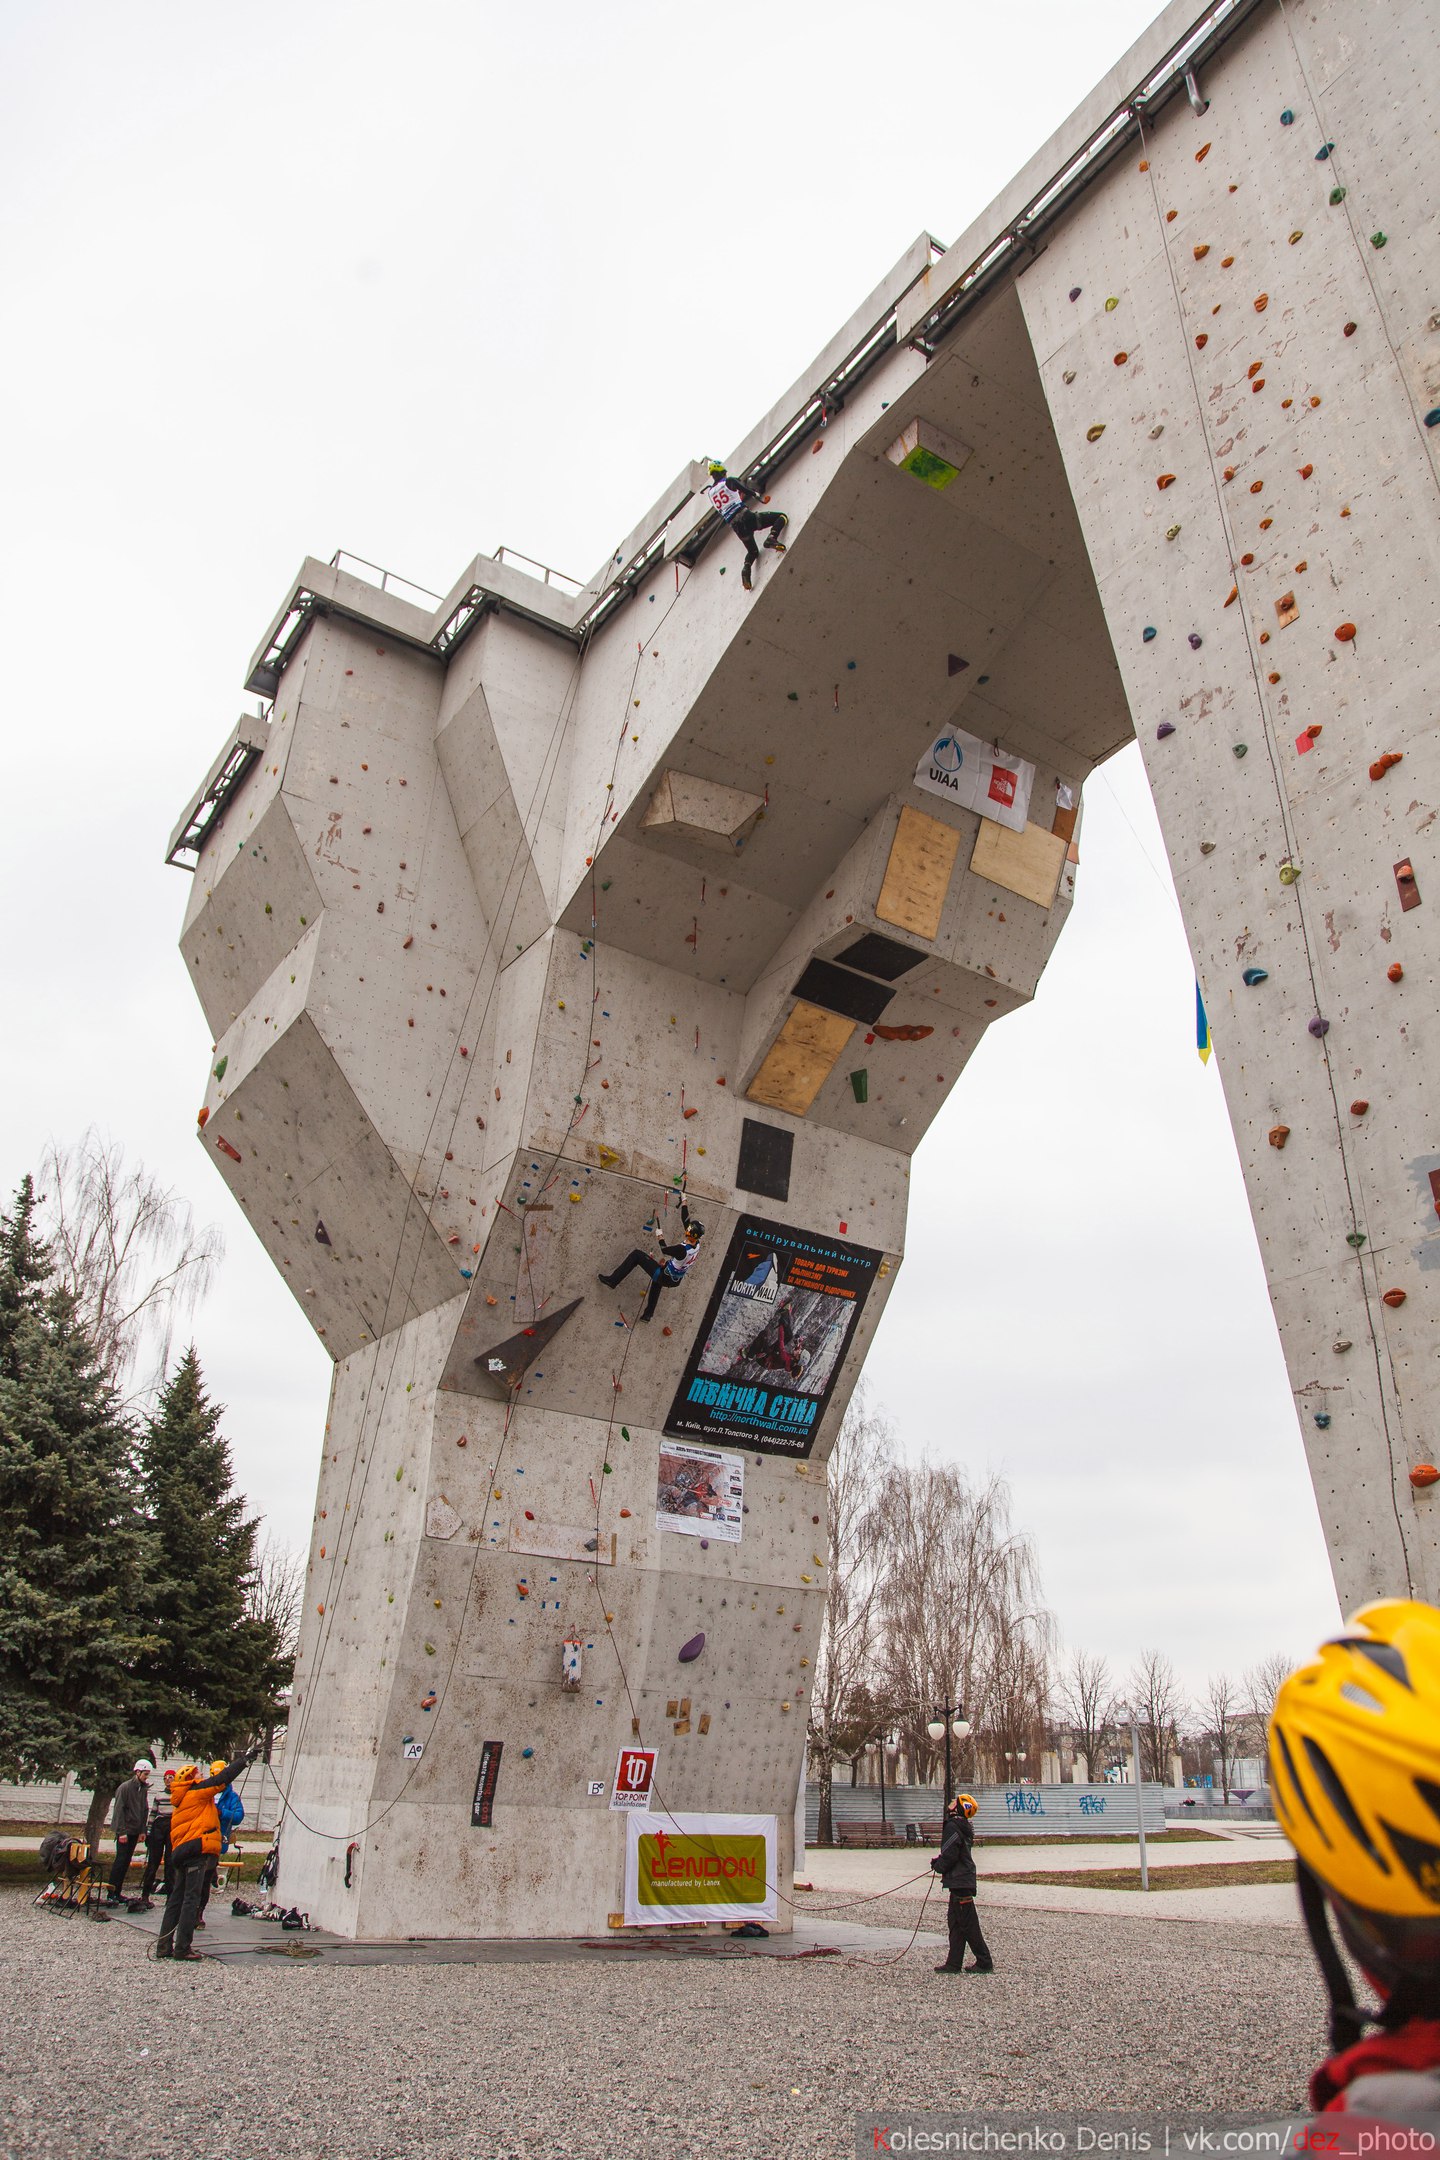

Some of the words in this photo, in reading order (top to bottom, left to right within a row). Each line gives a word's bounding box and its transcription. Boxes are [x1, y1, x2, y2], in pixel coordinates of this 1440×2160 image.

[712, 489, 730, 509] 55
[929, 768, 958, 791] UIAA
[839, 1255, 872, 1268] центр
[731, 1279, 757, 1296] NORTH
[756, 1286, 776, 1301] WALL
[685, 1421, 702, 1431] Київ,
[753, 1433, 760, 1442] 9,
[709, 1409, 809, 1436] http://northwall.com.ua
[615, 1793, 628, 1801] TOP
